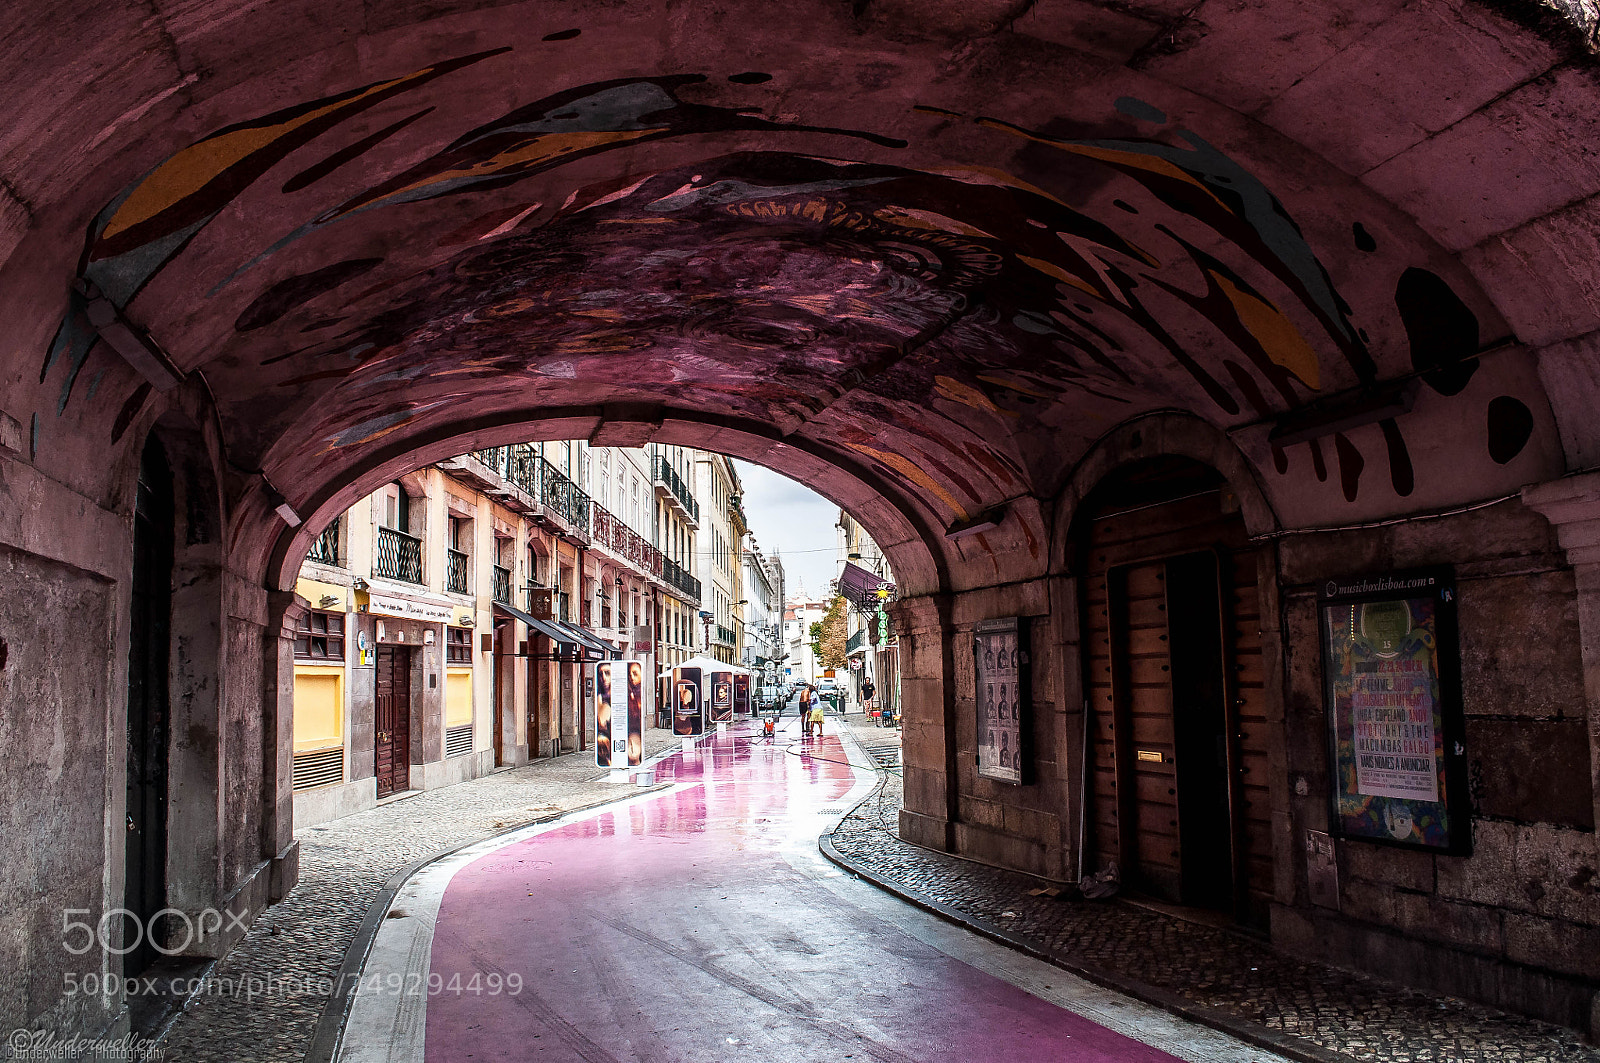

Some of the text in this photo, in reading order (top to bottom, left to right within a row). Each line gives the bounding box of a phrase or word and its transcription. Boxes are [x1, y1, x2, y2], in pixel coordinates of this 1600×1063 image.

[1338, 577, 1427, 594] musicboxlisboa.com
[1383, 640, 1391, 649] 15
[1359, 738, 1429, 755] MACUMBAS GALGO
[1361, 755, 1374, 768] MAIS
[1374, 755, 1395, 770] NOMES
[1400, 757, 1431, 772] ANUNCIAR
